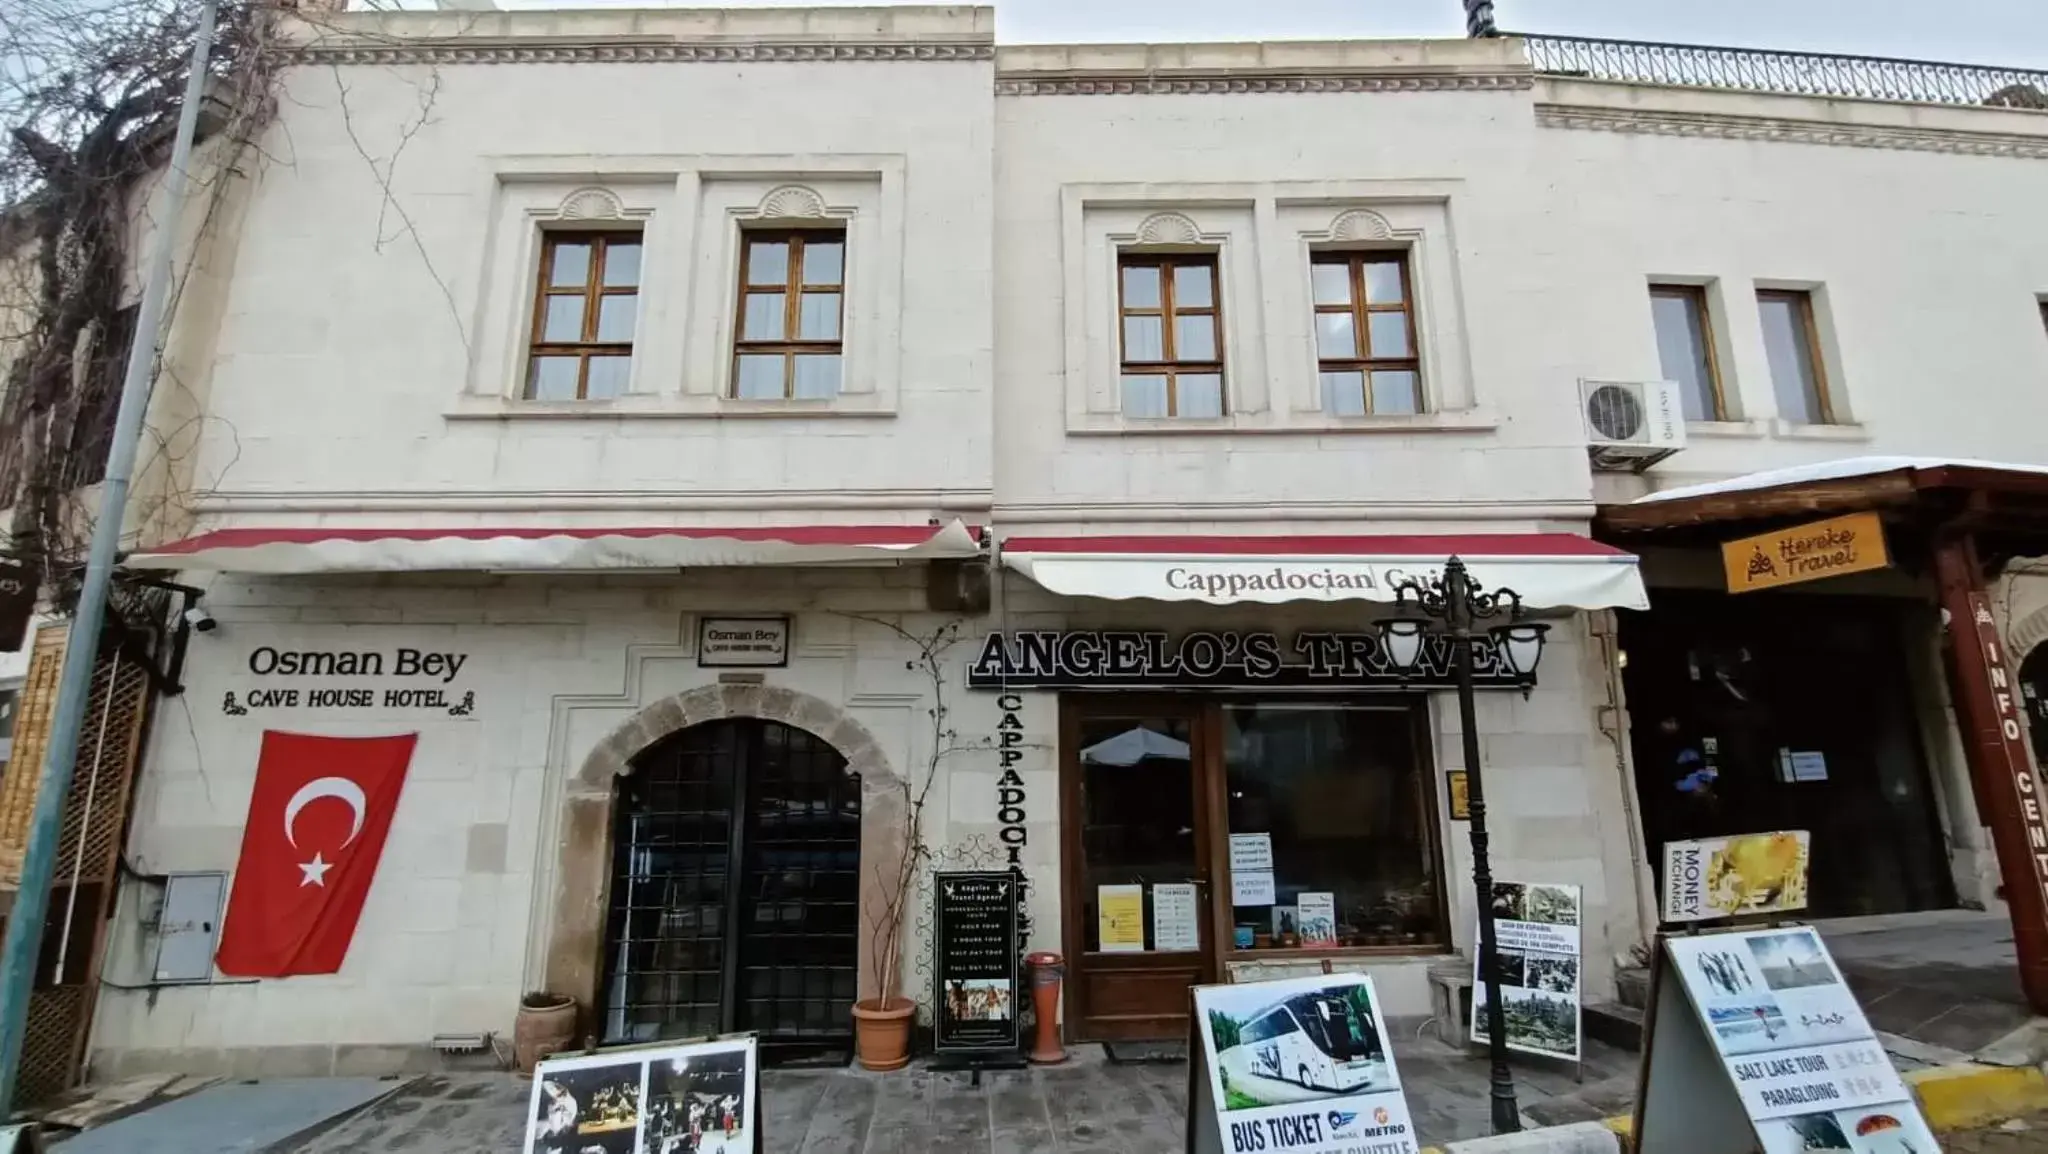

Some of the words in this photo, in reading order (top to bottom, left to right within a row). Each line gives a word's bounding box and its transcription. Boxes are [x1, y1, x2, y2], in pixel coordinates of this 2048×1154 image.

[1779, 529, 1856, 559] Hereke
[1784, 545, 1858, 576] Travel
[1165, 567, 1374, 597] Cappadocian
[1384, 568, 1480, 592] Gui
[708, 629, 752, 640] Osman
[755, 629, 779, 642] Bey
[249, 647, 384, 676] Osman
[393, 648, 468, 683] Bey
[972, 631, 1284, 678] ANGELO'S
[1295, 632, 1519, 678] TRVE
[247, 689, 300, 707] CAVE
[307, 689, 374, 707] HOUSE
[383, 689, 449, 707] HOTEL
[1988, 642, 2020, 741] INFO
[2017, 770, 2048, 902] CENT
[1671, 850, 1683, 916] EXCHANGE
[1684, 848, 1700, 916] MONEY
[1734, 1061, 1766, 1081] SALT
[1763, 1058, 1797, 1077] LAKE
[1794, 1054, 1829, 1073] TOUR
[1760, 1082, 1840, 1107] PARAGLIDING
[1231, 1119, 1266, 1152] BUS
[1266, 1113, 1323, 1148] TICKET
[1364, 1124, 1405, 1137] METRO
